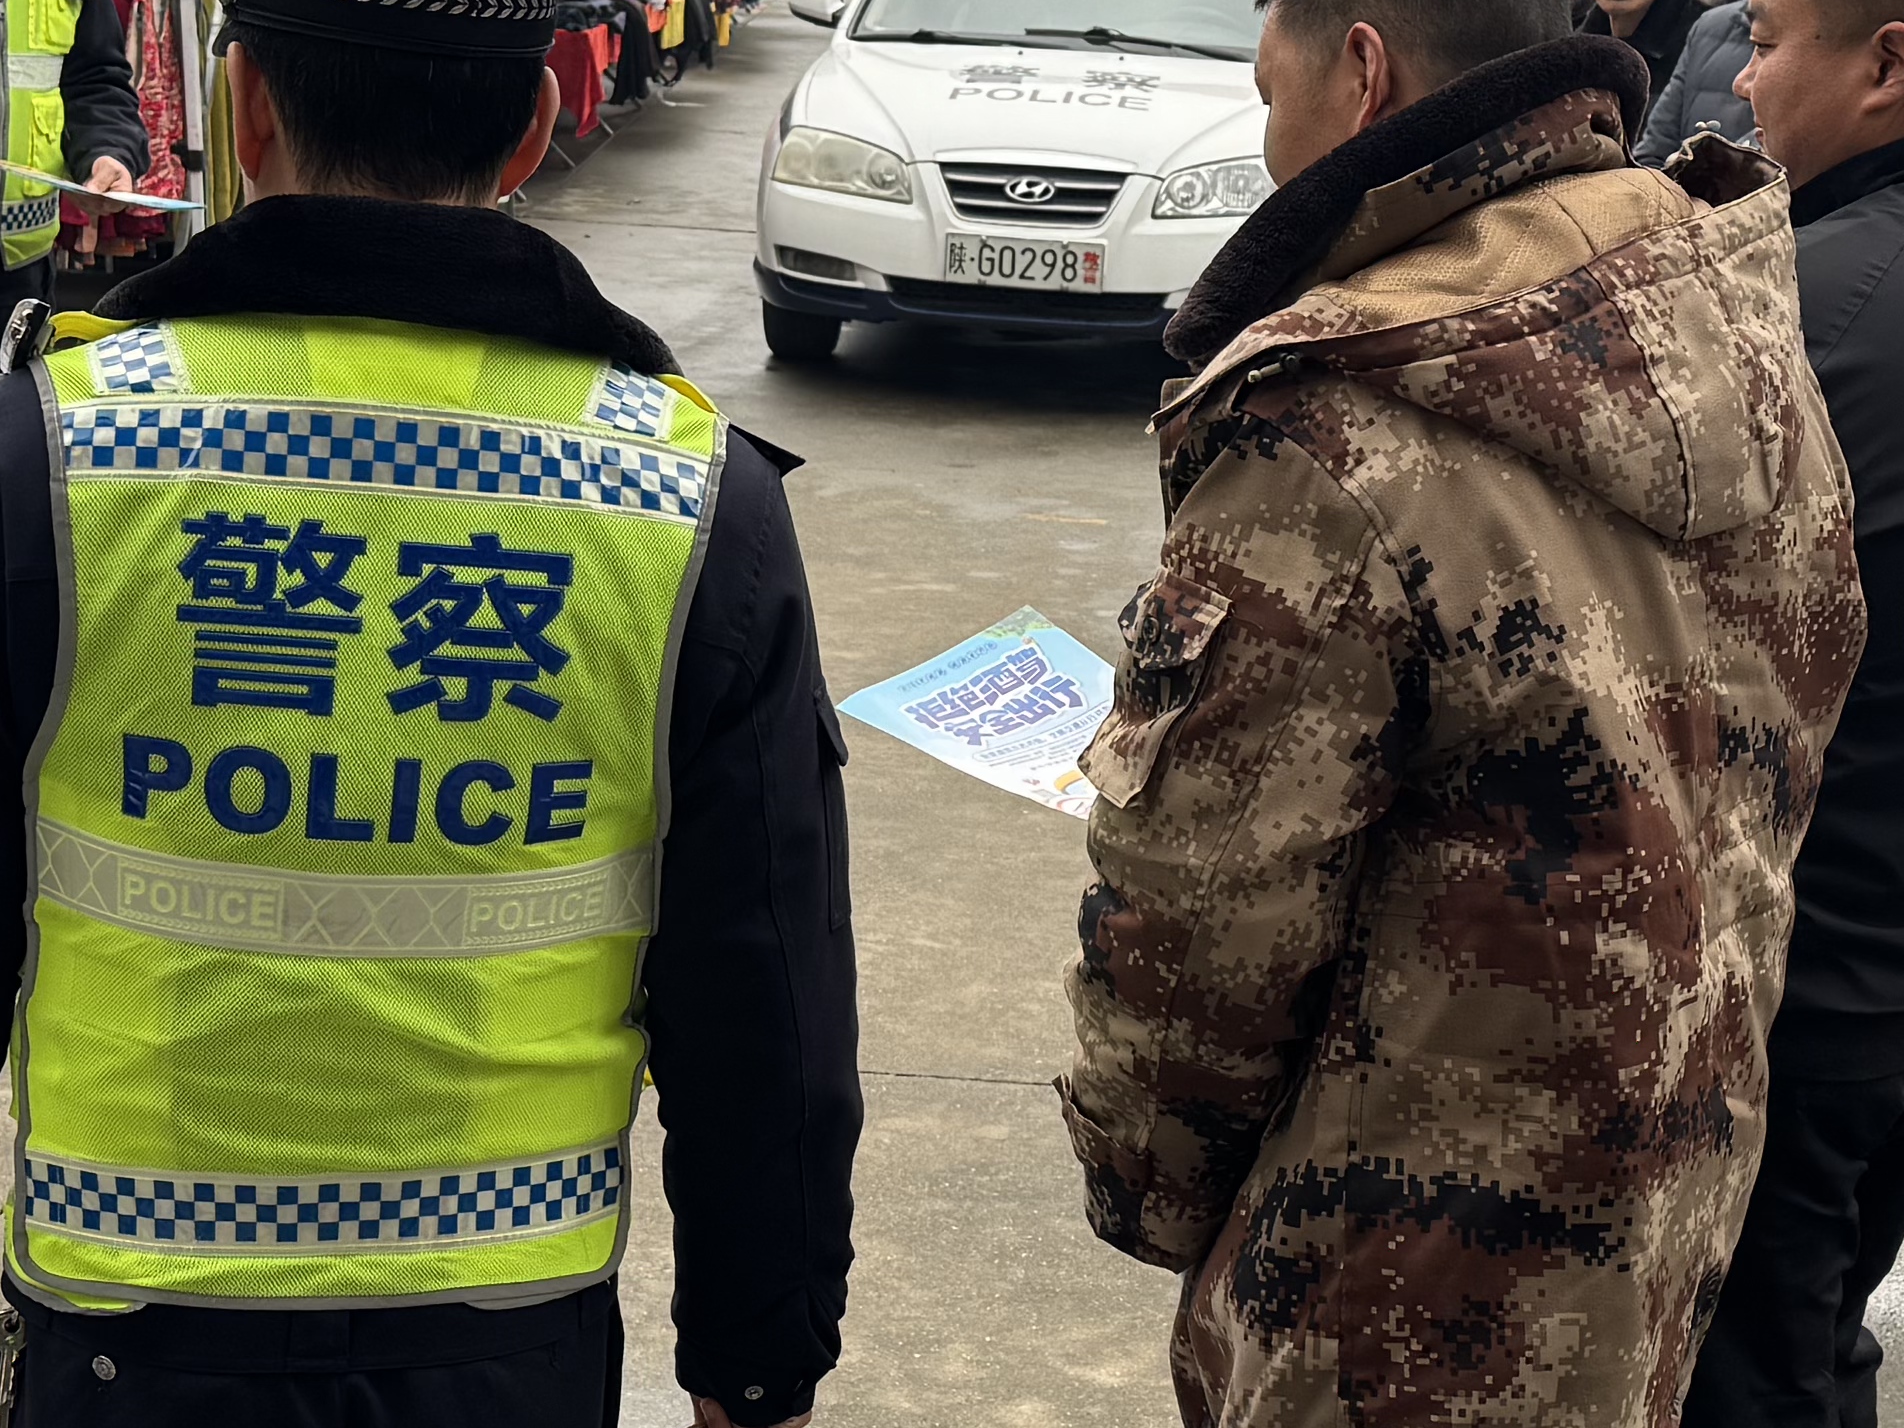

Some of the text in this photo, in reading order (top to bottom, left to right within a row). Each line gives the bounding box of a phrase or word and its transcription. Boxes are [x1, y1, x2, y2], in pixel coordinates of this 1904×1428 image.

[949, 87, 1152, 111] POLICE
[961, 64, 1161, 93] 警察
[176, 509, 576, 724] 警察
[121, 733, 594, 846] POLICE
[122, 873, 610, 936] POLICE POLICE
